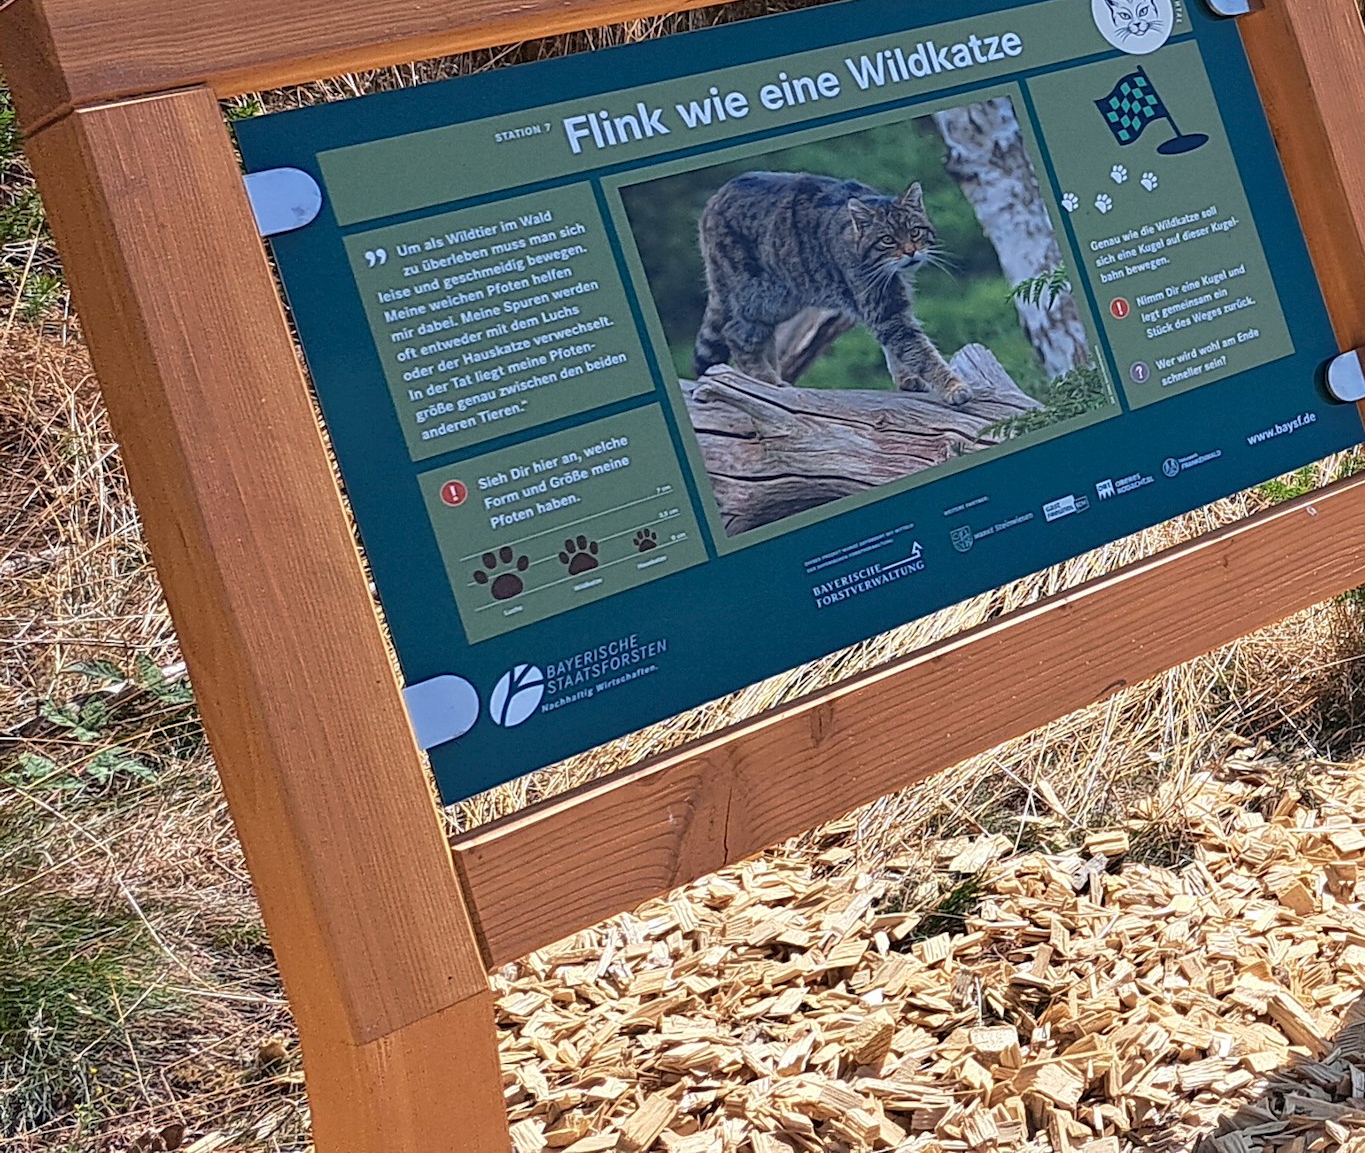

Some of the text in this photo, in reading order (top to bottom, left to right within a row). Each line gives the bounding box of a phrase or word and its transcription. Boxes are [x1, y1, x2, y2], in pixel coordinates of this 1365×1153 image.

[563, 32, 1023, 154] Flink wie eine Wildkatze
[494, 122, 551, 143] STATION 7
[396, 210, 553, 257] Um als Wildtier im Wald
[402, 223, 586, 277] zu überleben muss man sich
[1090, 205, 1217, 251] Genau wie die Wildkatze soll
[1095, 216, 1240, 267] sich eine Kugel auf dieser Kugel-
[377, 245, 588, 303] leise und geschmeidig bewegen.
[1099, 257, 1170, 283] bahn bewegen.
[1136, 263, 1246, 307] Nimm Dir eine Kugel und
[383, 268, 573, 323] Meine weichen Pfoten helfen
[390, 281, 599, 342] mir dabei. Meine Spuren werden
[1140, 288, 1228, 323] legt gemeinsam ein
[1146, 296, 1256, 339] Stück des Weges zurück.
[397, 306, 580, 362] oft entweder mit dem Luchs
[403, 316, 615, 382] oder der Hauskatze verwechselt.
[1155, 328, 1260, 370] Wer wird wohl am Ende
[408, 343, 596, 401] In der Tat liegt meine Pfoten-
[415, 353, 627, 423] größe genau zwischen den beiden
[1161, 355, 1227, 386] schneller sein?
[421, 417, 477, 440] anderen
[1246, 412, 1317, 445] www.baysf.de
[477, 437, 628, 490] Sieh Dir hier an, welche
[483, 457, 630, 510] Form und Größe meine
[490, 494, 581, 529] Pfoten haben.
[812, 563, 882, 597] BAYERISCHE
[816, 560, 925, 609] FORSTVERWALTUNG
[546, 633, 638, 679] BAYERISCHE
[547, 638, 667, 695] STAATSFORSTEN
[541, 664, 659, 713] Nachhaltig Wirtschaften.
